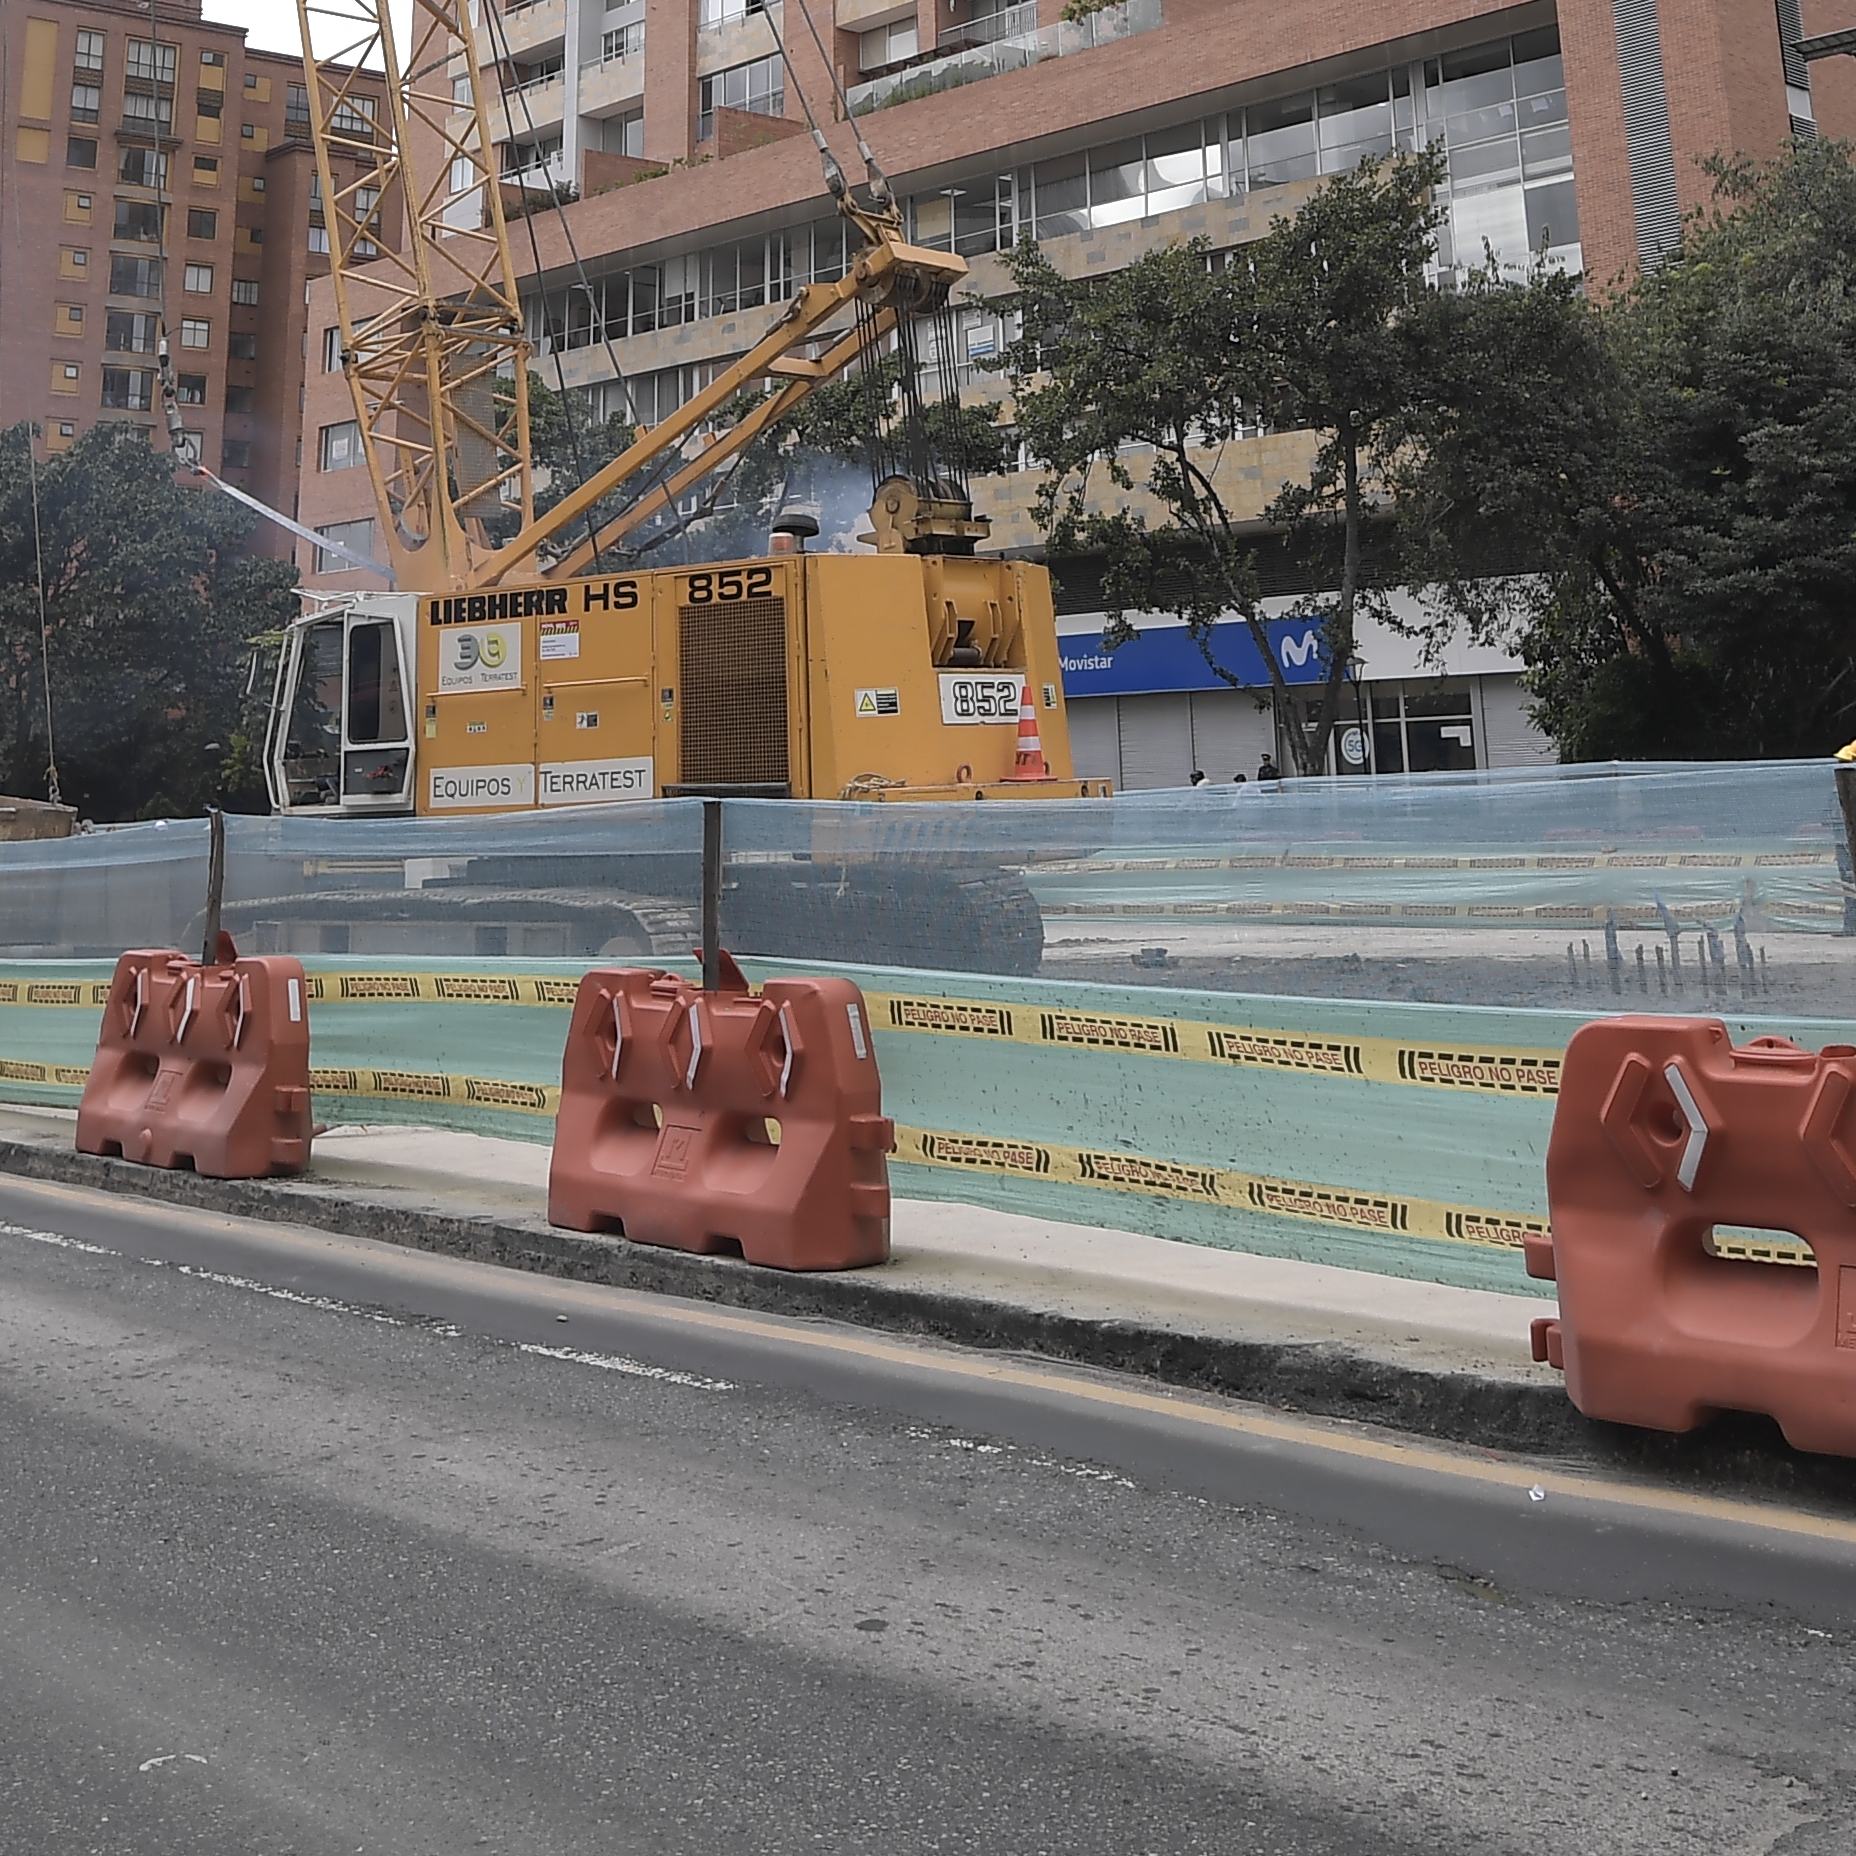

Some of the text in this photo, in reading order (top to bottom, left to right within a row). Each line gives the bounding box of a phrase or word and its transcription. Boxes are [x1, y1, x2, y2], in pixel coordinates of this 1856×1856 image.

[430, 567, 772, 625] LIEBHERR HS 852
[1058, 654, 1114, 672] Movistar
[952, 681, 1019, 717] 852
[433, 776, 511, 799] EQUIPOS
[540, 769, 646, 793] TERRATEST
[904, 1007, 998, 1027] PELIGRO NO PASE
[1057, 1021, 1161, 1043] PELIGRO NO PASE
[1226, 1039, 1342, 1065] PELIGRO NO PASE
[1418, 1061, 1558, 1086] PELIGRO NO PASE
[1003, 1151, 1033, 1165] PASE
[1325, 1202, 1348, 1217] NO
[1350, 1207, 1387, 1223] PASE
